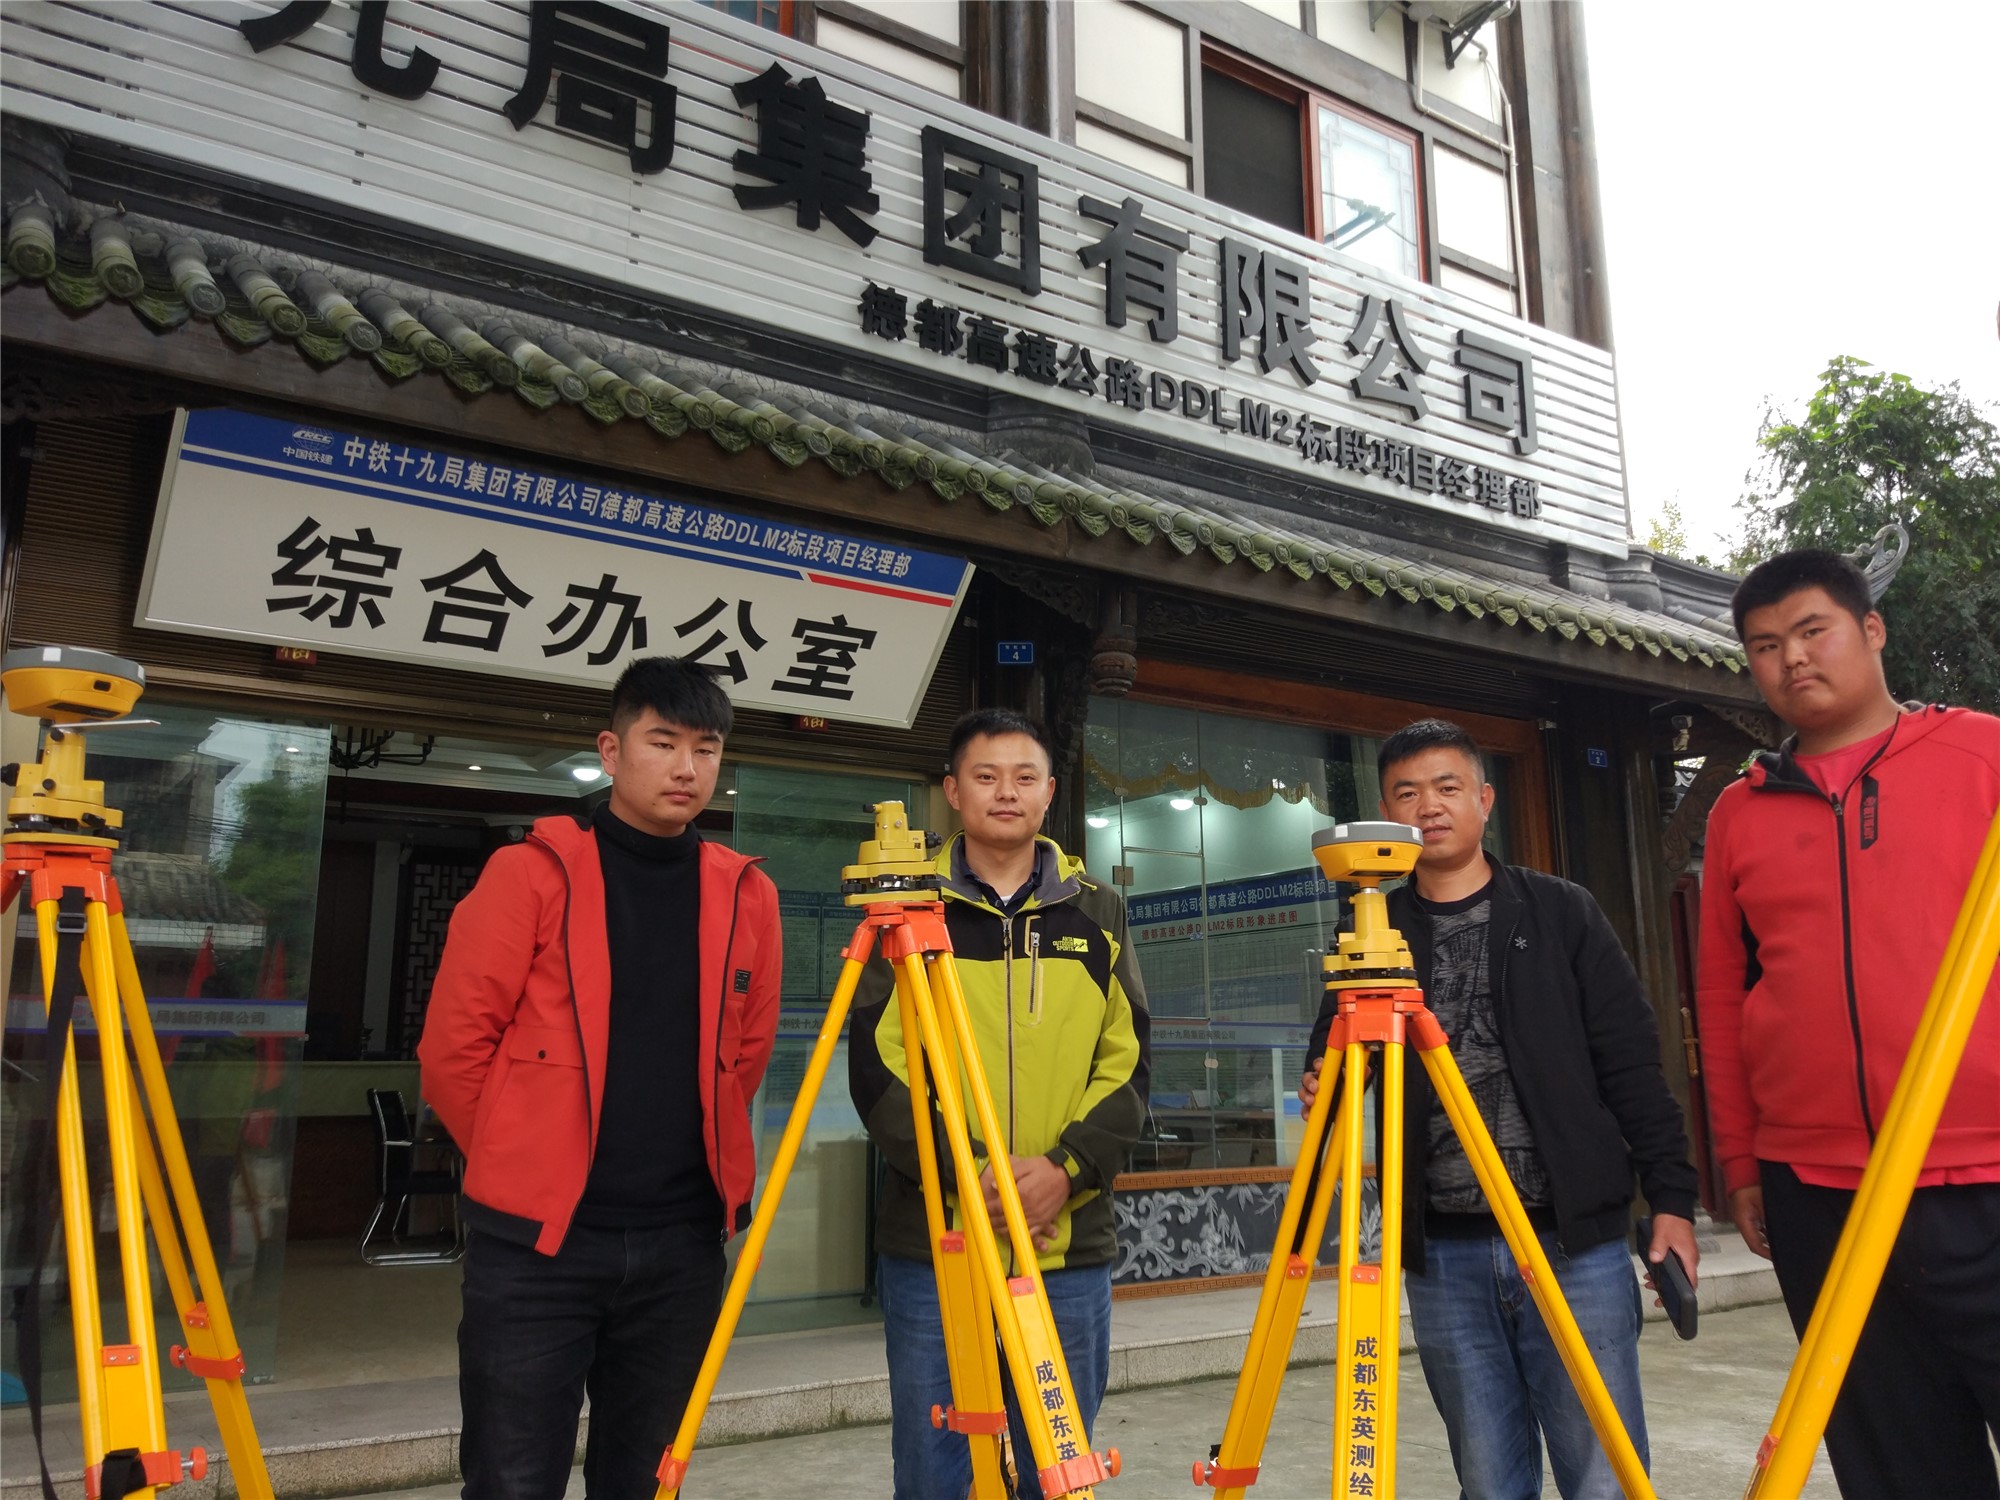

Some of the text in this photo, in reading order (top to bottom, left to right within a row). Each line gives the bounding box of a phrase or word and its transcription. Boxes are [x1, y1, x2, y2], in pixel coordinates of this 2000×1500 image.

[282, 446, 333, 465] 中国铁建
[857, 281, 1543, 519] 德都高速公路DDLM2标段项目经理部
[343, 436, 912, 578] 中铁十九局集团有限公司德都高速公路DDLM2标段项目经理部
[266, 516, 877, 701] 综合办公室
[1141, 911, 1298, 941] 德都高速公路DLM2标段形象进度图
[150, 1010, 266, 1025] 局集团有限公司
[1036, 1360, 1090, 1496] 成都东英
[1349, 1336, 1378, 1497] 成都东英测绘
